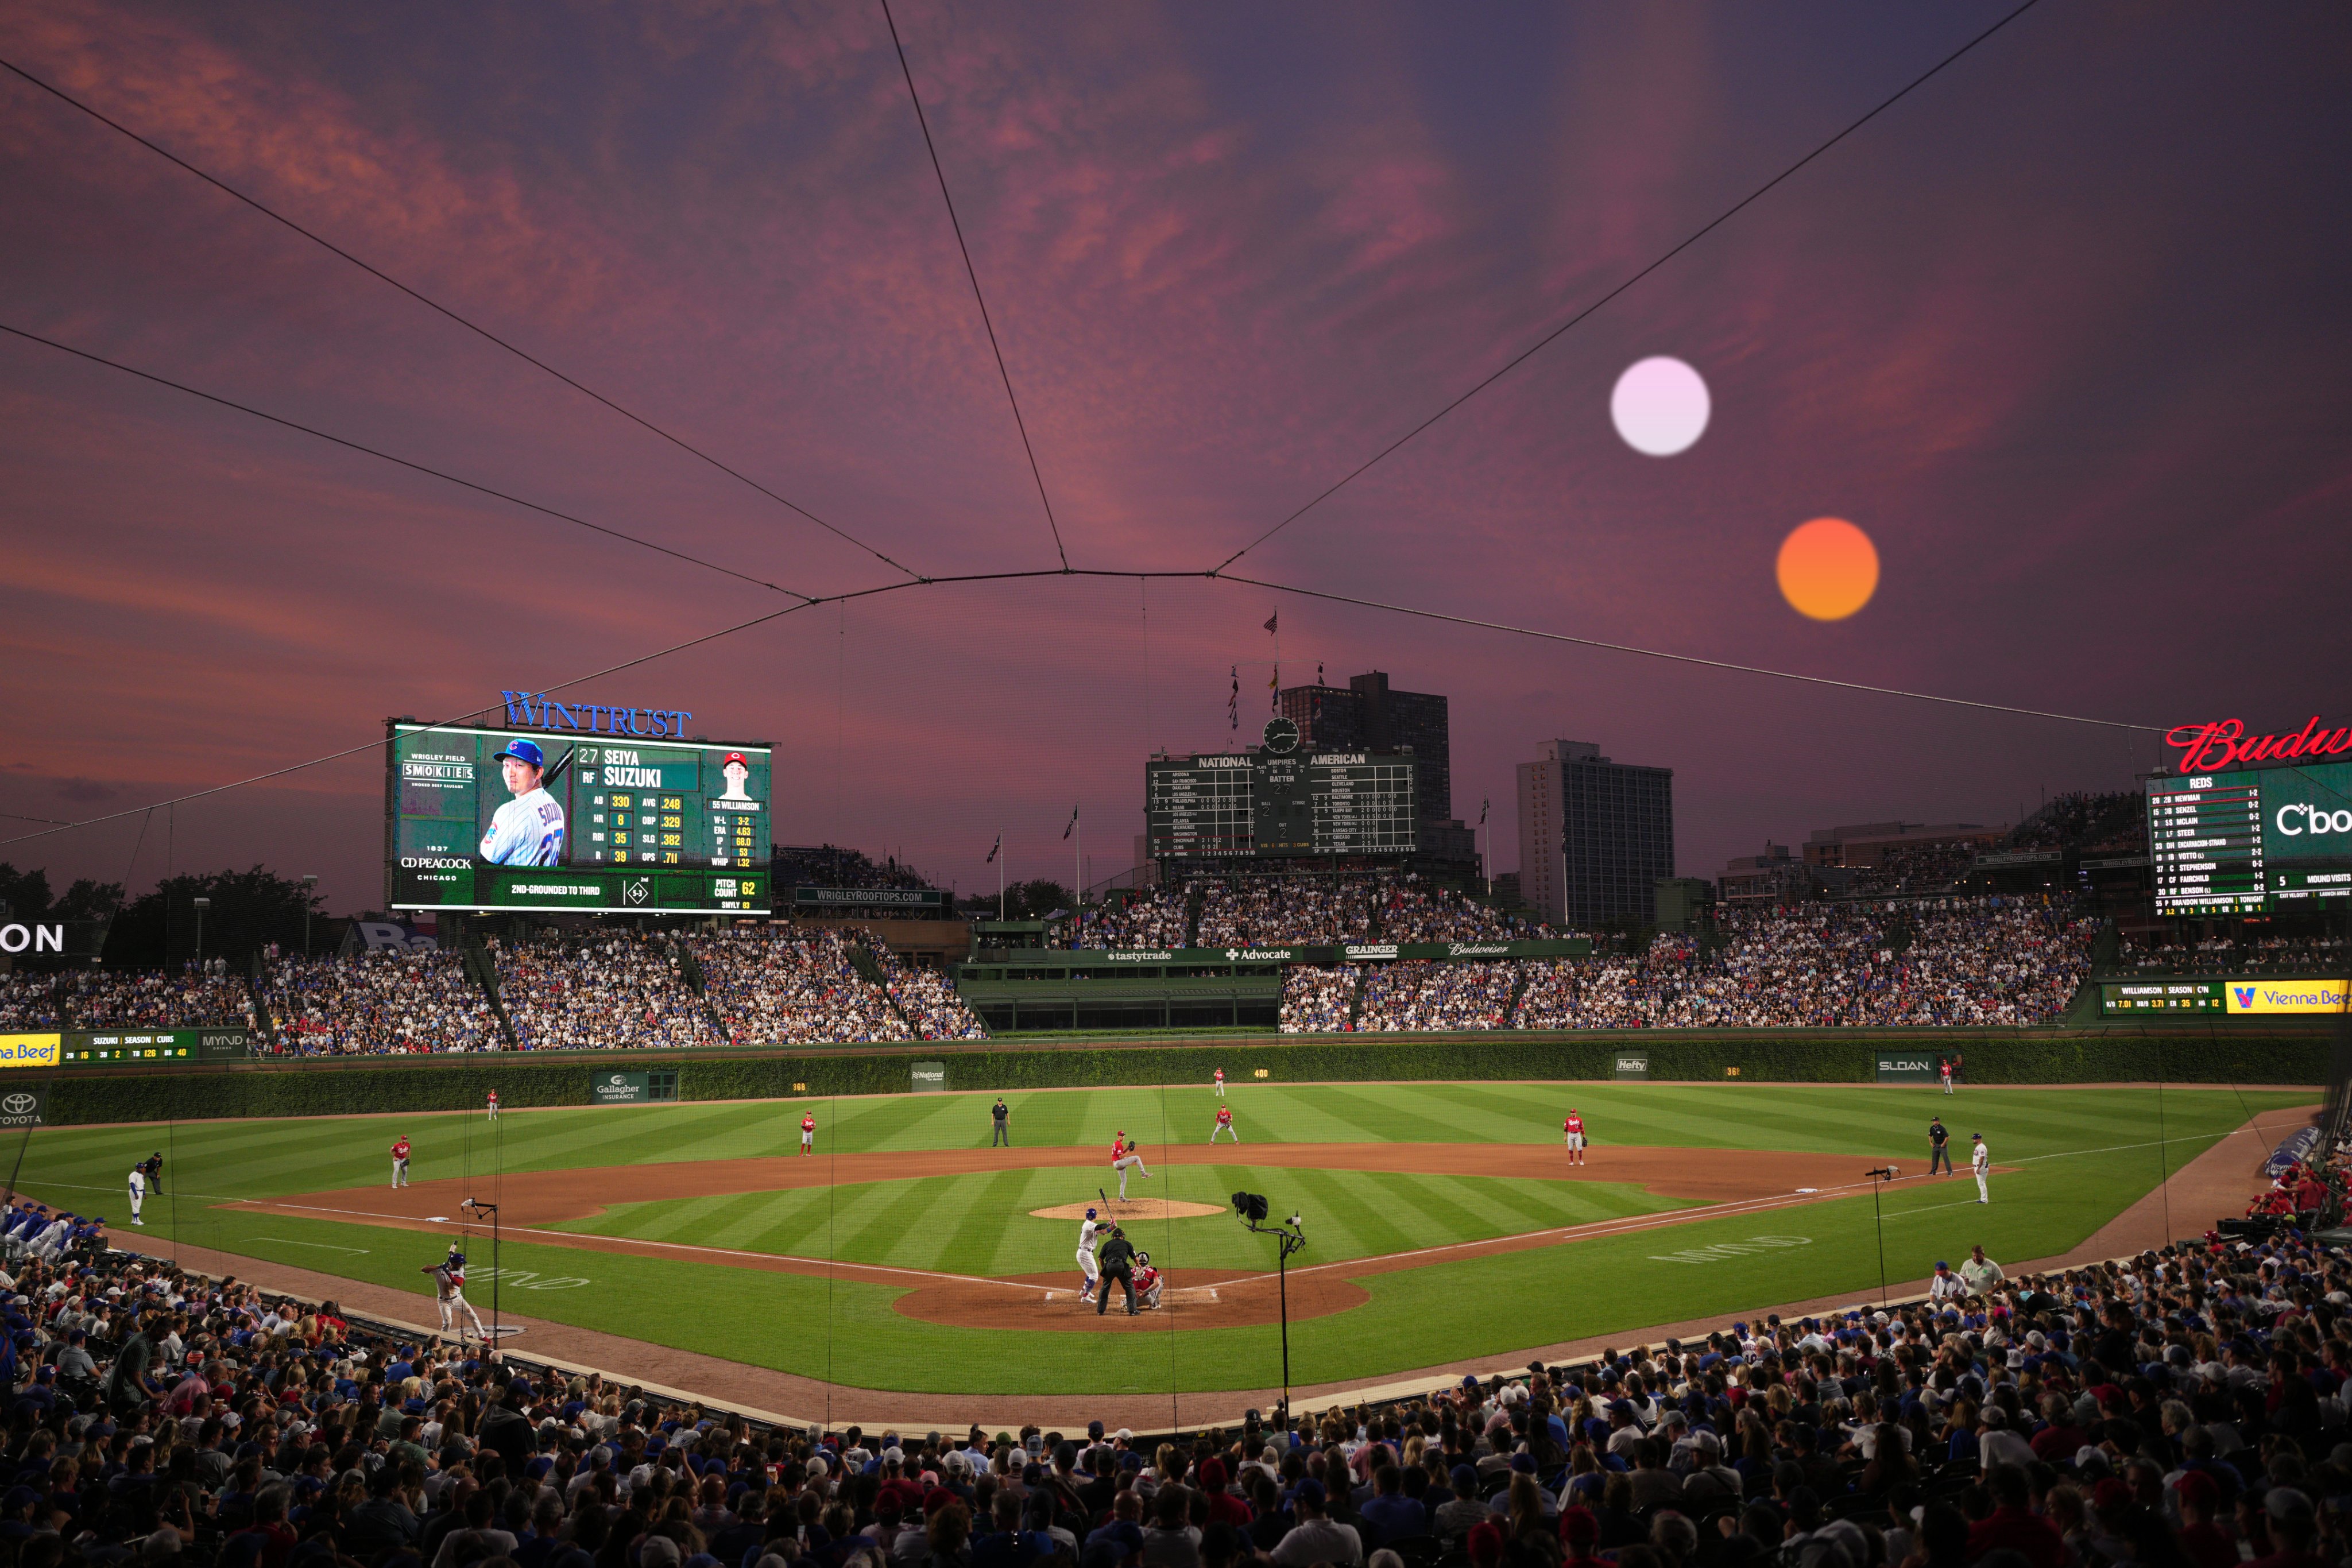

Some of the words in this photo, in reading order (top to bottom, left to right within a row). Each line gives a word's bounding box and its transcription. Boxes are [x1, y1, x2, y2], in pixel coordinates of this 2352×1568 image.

[501, 691, 692, 737] WINTRUST
[411, 753, 443, 761] WRIGLEY
[579, 749, 598, 763] 27
[605, 750, 639, 765] SEIYA
[1310, 754, 1365, 765] AMERICAN
[1198, 757, 1253, 768] NATIONAL
[583, 772, 594, 783] RF
[605, 768, 661, 788] SUZUKI
[2189, 777, 2212, 789] REDS
[594, 796, 603, 804] AB
[613, 796, 629, 807] 330
[2175, 794, 2200, 802] NEWMAN
[643, 799, 655, 807] AVG
[661, 799, 680, 810] .248
[721, 802, 759, 811] WILLIAMSON
[2176, 806, 2197, 814] SENZEL
[594, 815, 604, 823] HR
[618, 815, 624, 825] 8
[643, 816, 656, 825] OBP
[661, 816, 680, 827] .329
[714, 816, 726, 824] W-L
[738, 817, 749, 825] 3-2
[2176, 818, 2198, 826] MCLAIN
[2249, 812, 2259, 820] 0-2
[714, 827, 726, 835] ERA
[736, 827, 751, 835] 4.63
[593, 833, 604, 841] RBI
[615, 833, 626, 843] 35
[643, 835, 655, 843] SLG
[661, 835, 680, 846] .382
[717, 837, 724, 845] IP
[736, 838, 751, 846] 68.0
[2178, 839, 2226, 848] ENCARNACION-STRAND
[595, 851, 601, 860] R
[615, 851, 626, 862] 39
[740, 848, 748, 857] 53
[401, 858, 416, 868] CD
[419, 859, 471, 869] PEACOCK
[643, 853, 655, 861] OPS
[663, 853, 678, 864] .711
[712, 858, 729, 866] WHIP
[737, 859, 750, 867] 1.32
[2179, 862, 2216, 872] STEPHENSON
[716, 879, 736, 888] PITCH
[2180, 875, 2209, 883] FAIRCHILD
[2280, 876, 2285, 886] 5
[2308, 874, 2330, 883] MOUND
[2331, 873, 2351, 882] VISITS
[512, 885, 567, 895] 2ND-GROUNDED
[568, 886, 578, 895] TO
[579, 886, 599, 895] THIRD
[714, 889, 737, 897] COUNT
[742, 882, 755, 895] 62
[817, 889, 922, 903] WRIGLEYROOFTOPS.COM
[2172, 897, 2198, 907] BRANDON
[2199, 897, 2233, 905] WILLIAMSON
[1345, 945, 1398, 955] GRAINGER
[1448, 942, 1509, 956] Budweiser
[1115, 951, 1171, 962] tastytrade
[1241, 949, 1291, 960] Advocate
[2122, 987, 2162, 995] WILLIAMSON
[2264, 990, 2318, 1005] Vienna
[2322, 990, 2352, 1004] Bee
[2118, 1000, 2131, 1008] 7.01
[2152, 1000, 2164, 1008] 3.71
[2181, 999, 2190, 1008] 35
[2212, 999, 2219, 1007] 12
[94, 1037, 118, 1045] SUZUKI
[125, 1036, 151, 1044] SEASON
[157, 1035, 174, 1043] CUBS
[203, 1036, 242, 1046] MYND
[18, 1044, 55, 1062] Beef
[80, 1051, 88, 1059] 16
[177, 1048, 186, 1056] 40
[1619, 1060, 1645, 1069] Hefty
[1879, 1061, 1929, 1071] SLOAN
[1254, 1068, 1268, 1078] 400
[1727, 1067, 1740, 1076] 368
[597, 1085, 639, 1095] Gallagher
[792, 1083, 805, 1091] 368
